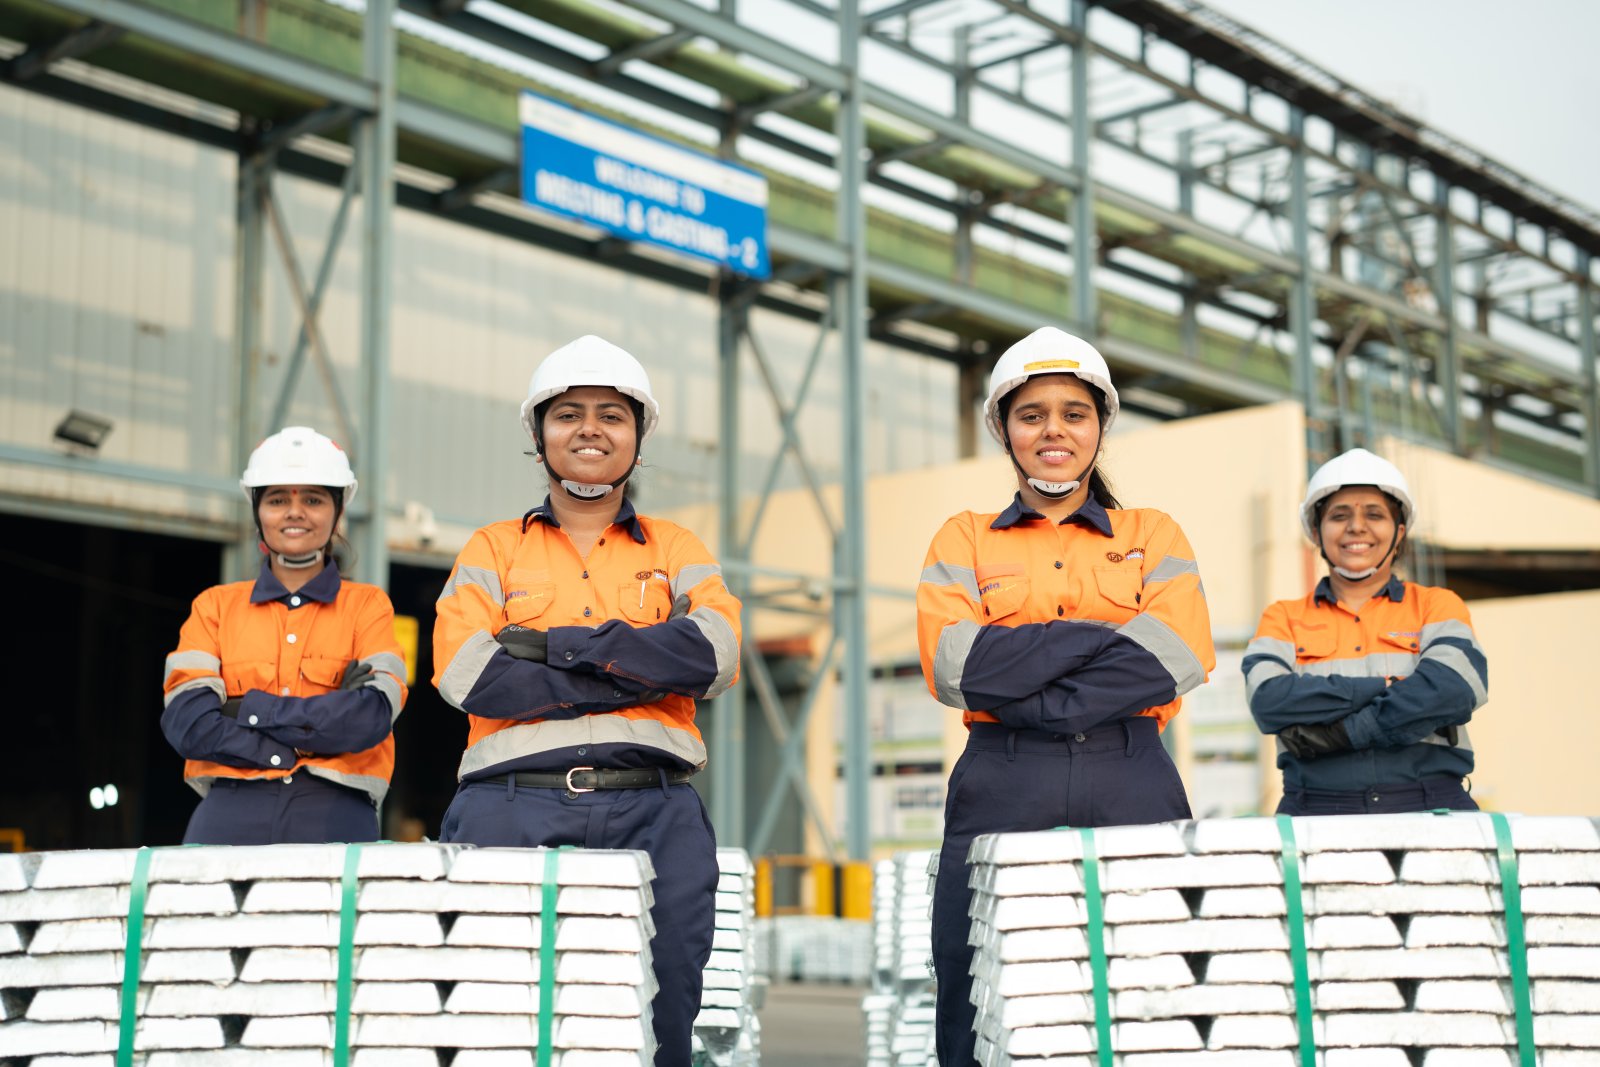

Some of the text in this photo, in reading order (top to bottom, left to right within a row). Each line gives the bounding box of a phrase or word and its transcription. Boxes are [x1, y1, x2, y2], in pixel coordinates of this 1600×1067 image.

[535, 168, 626, 228] MELTING
[626, 198, 645, 234] &
[646, 205, 729, 260] CASTING
[740, 236, 759, 270] 2
[594, 154, 680, 208] WELCOME
[680, 182, 706, 216] TO
